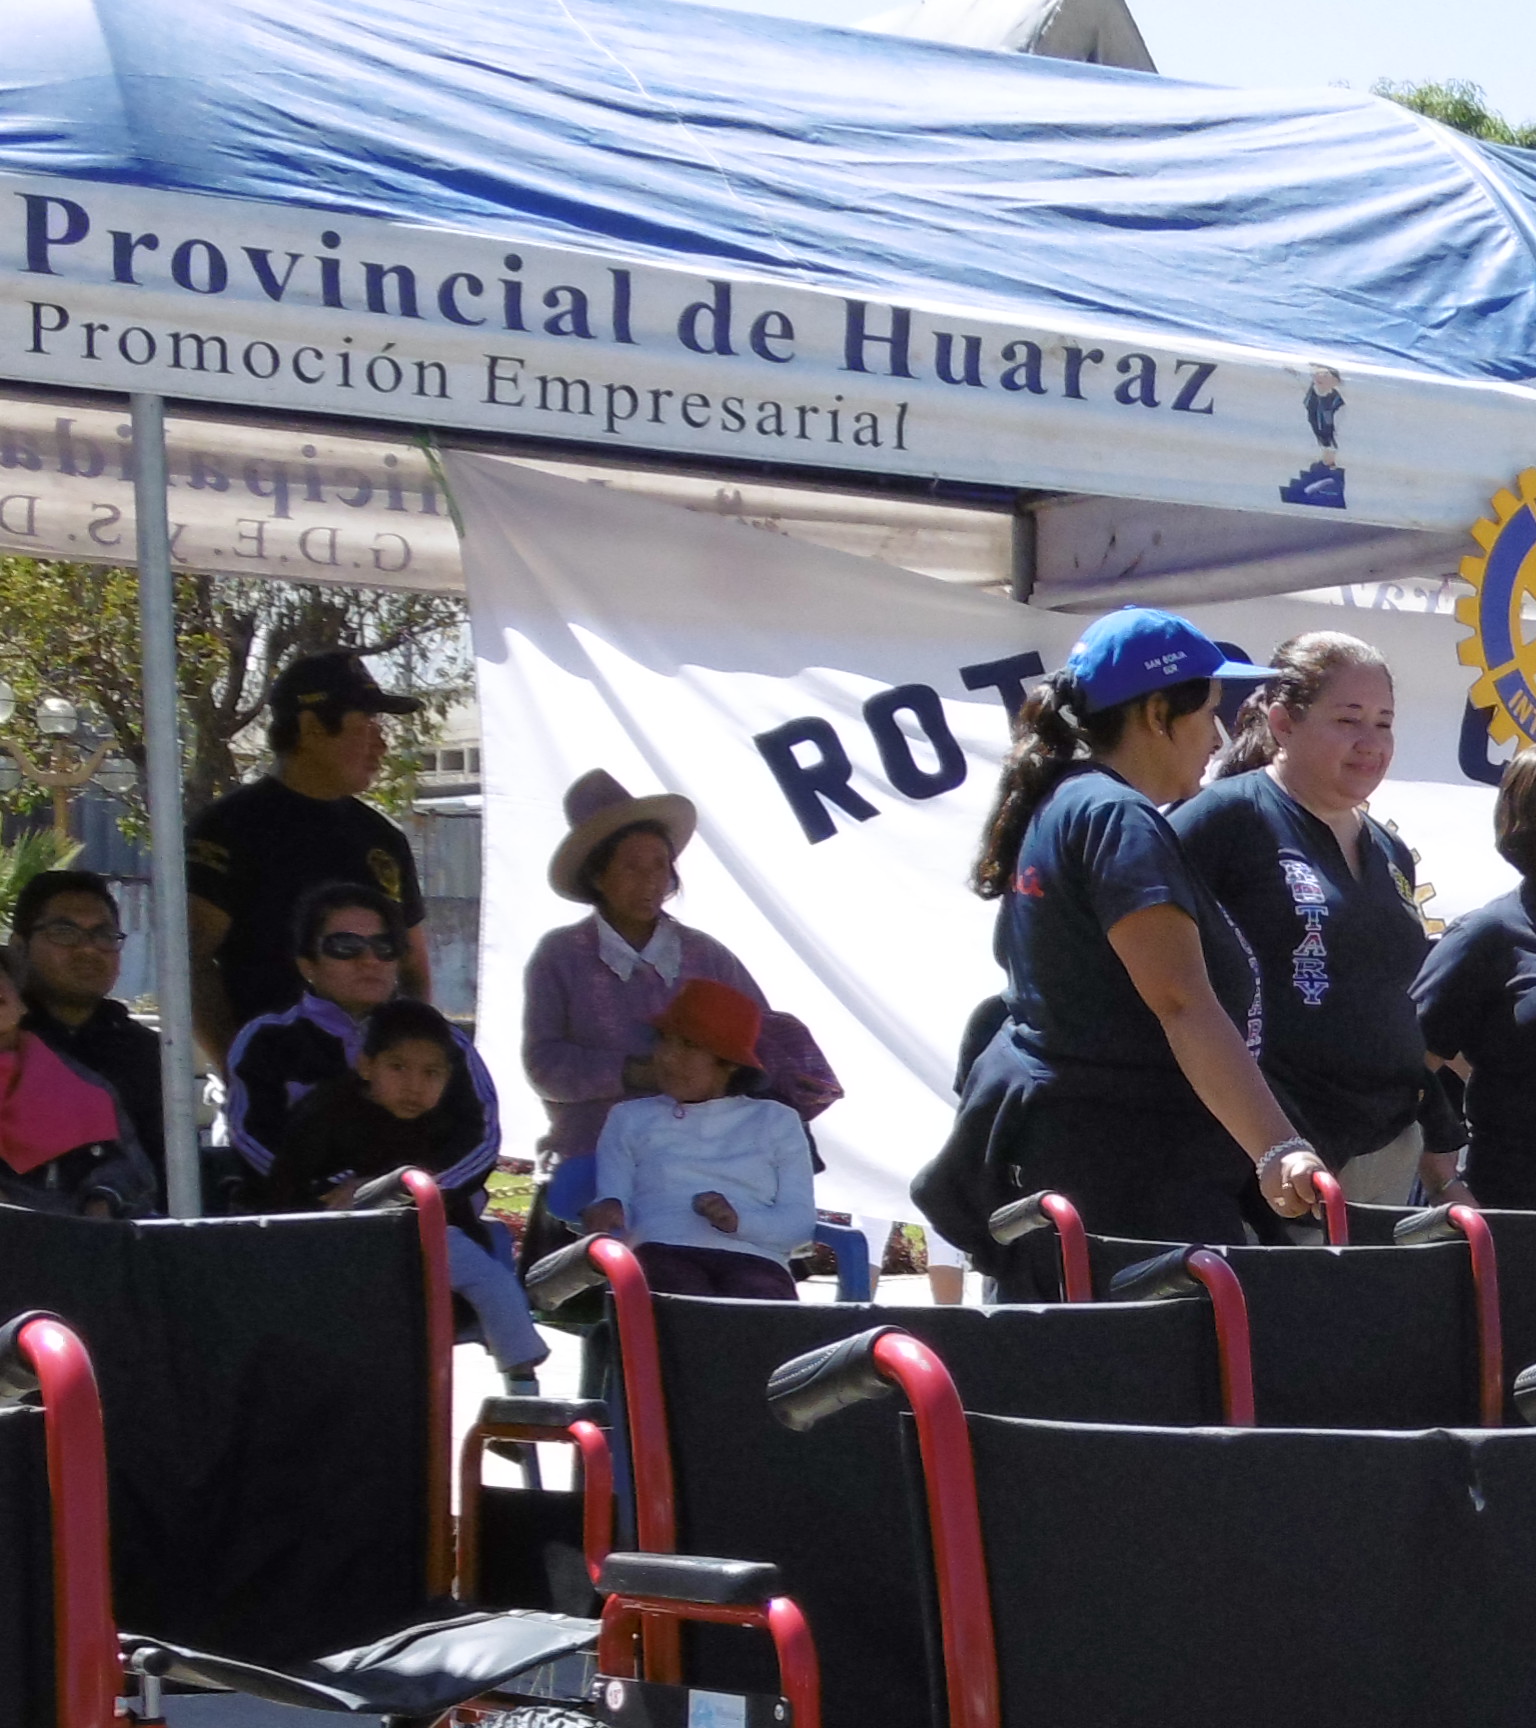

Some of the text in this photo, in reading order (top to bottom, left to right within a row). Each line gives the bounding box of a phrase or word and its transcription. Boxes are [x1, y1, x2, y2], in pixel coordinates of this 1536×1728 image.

[15, 192, 1220, 416] Provincial de Huaraz
[25, 300, 910, 452] Promoción Empresarial
